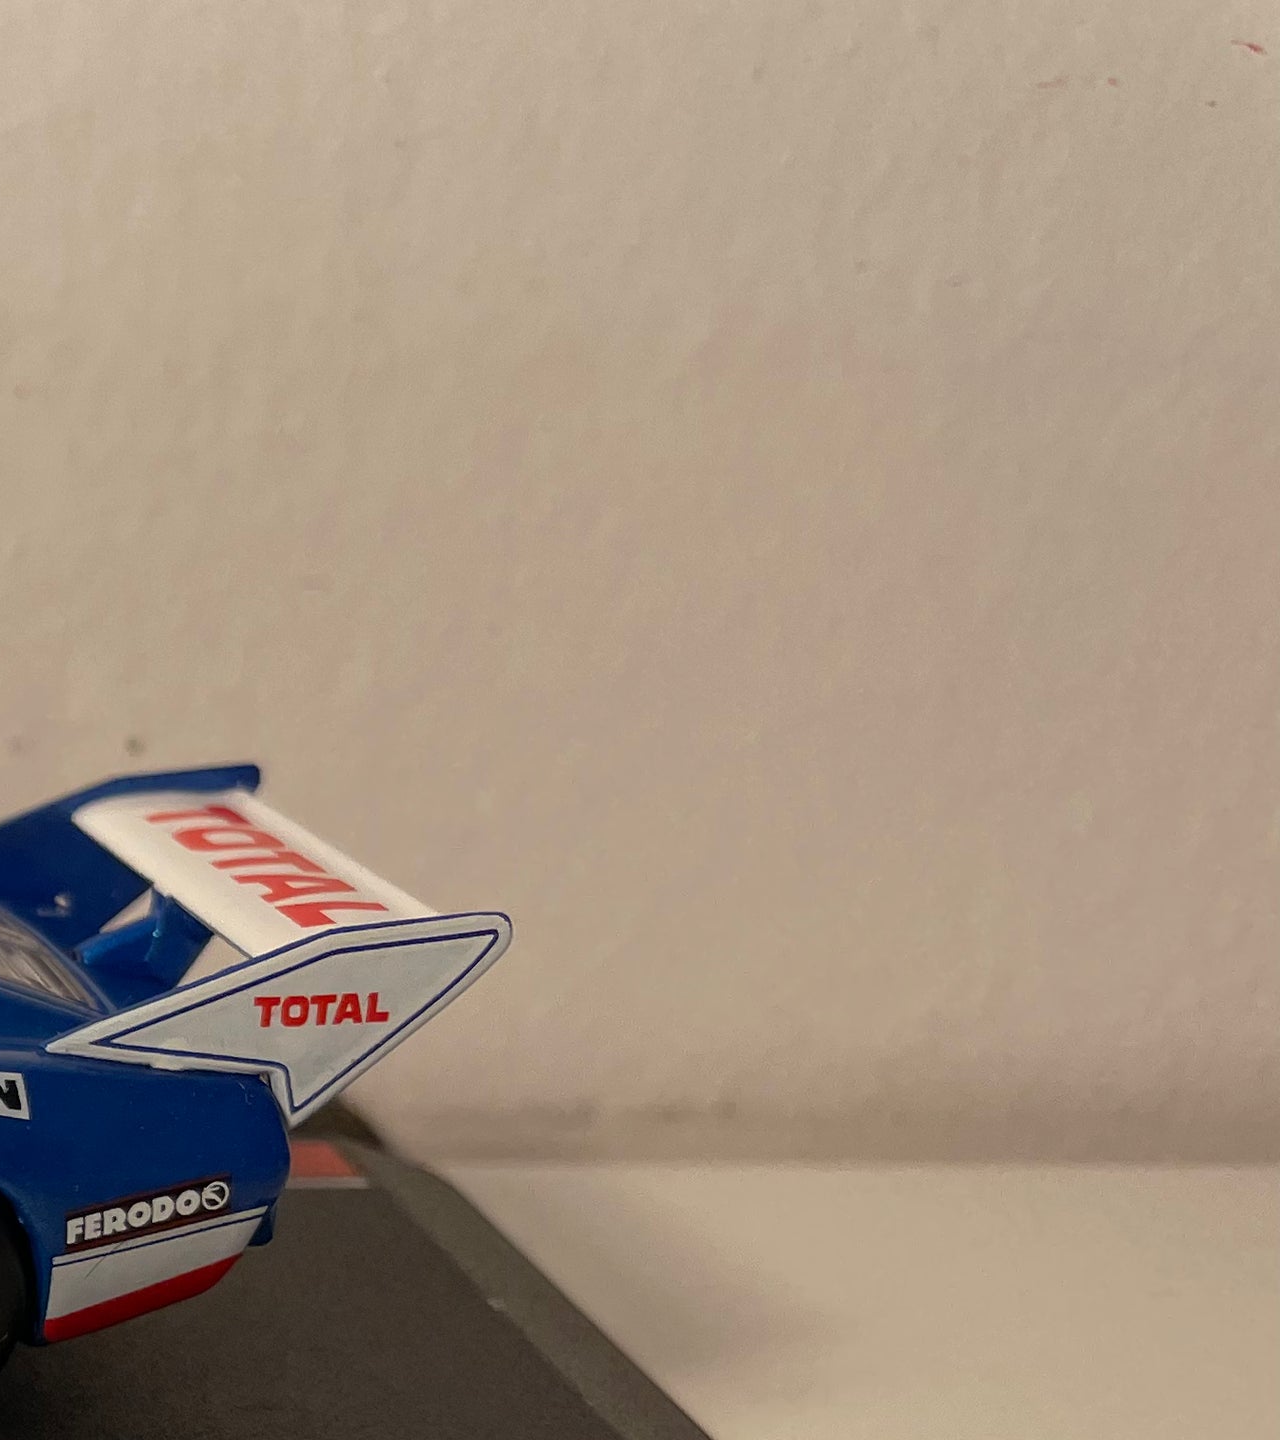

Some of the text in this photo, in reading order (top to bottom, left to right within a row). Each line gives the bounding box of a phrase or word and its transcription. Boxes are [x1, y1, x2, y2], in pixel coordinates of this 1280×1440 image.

[146, 804, 389, 928] TOTAL
[254, 992, 389, 1028] TOTAL
[66, 1189, 201, 1245] FERODO
